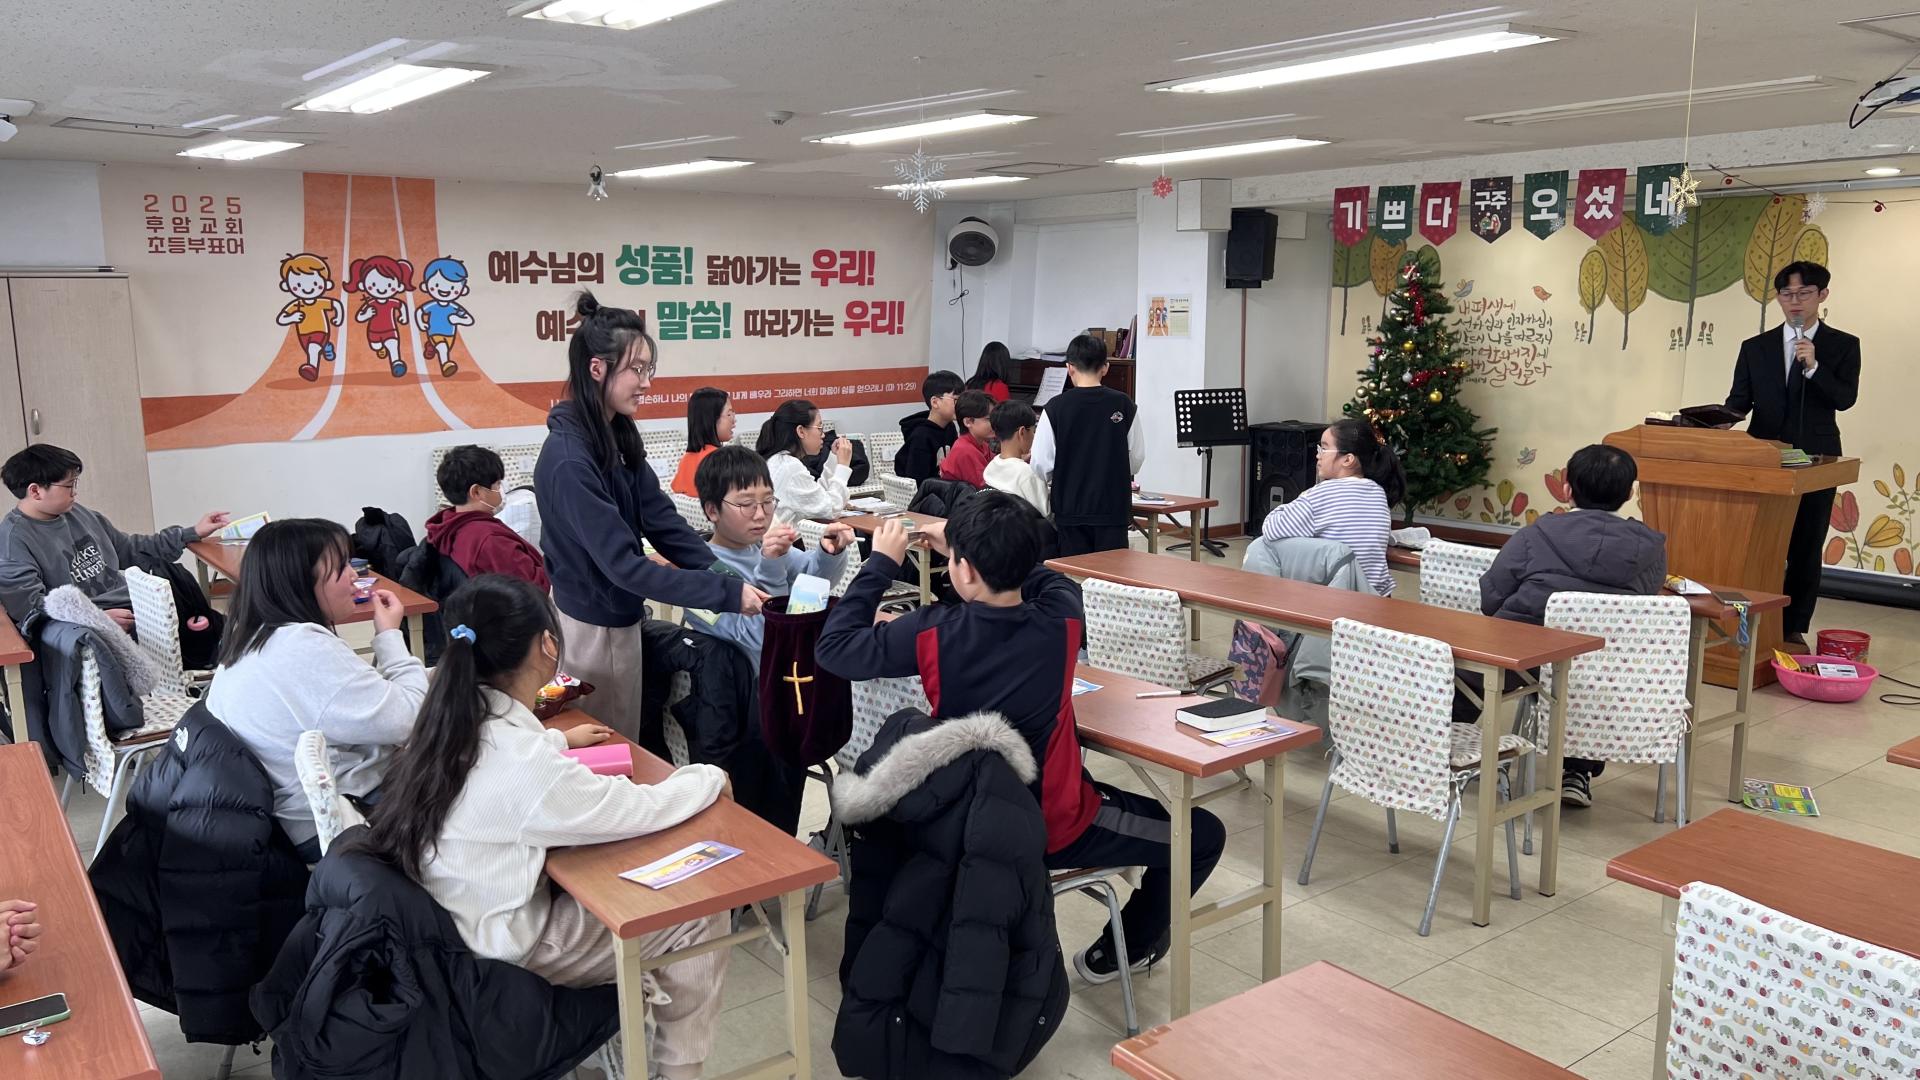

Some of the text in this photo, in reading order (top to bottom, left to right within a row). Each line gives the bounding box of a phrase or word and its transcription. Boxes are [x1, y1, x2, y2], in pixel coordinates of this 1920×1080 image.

[144, 194, 241, 214] 2025
[1475, 190, 1507, 211] 구주
[145, 216, 243, 234] 후암교회
[148, 236, 244, 254] 초등부표어
[488, 244, 875, 286] 예수님의 성품! 닮아가는 우리!
[657, 301, 731, 340] 말씀!
[744, 308, 834, 337] 따라가는
[844, 301, 904, 336] 우리!
[671, 394, 688, 405] 나의
